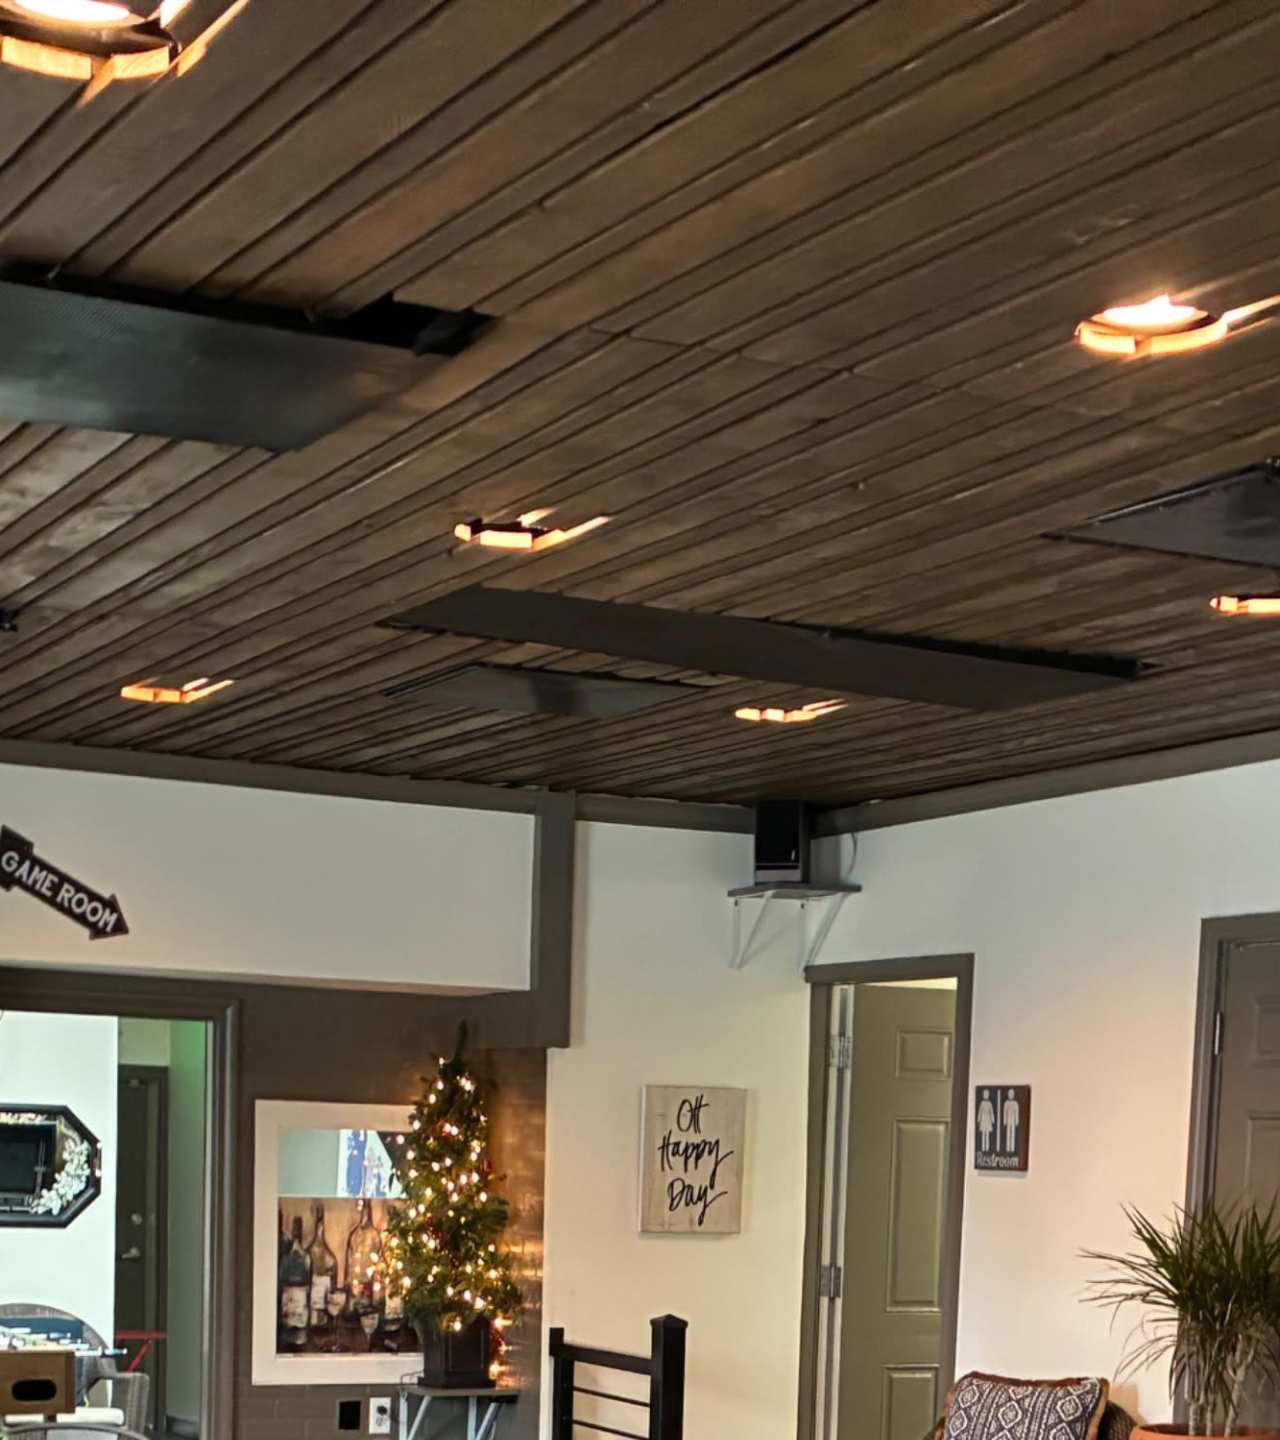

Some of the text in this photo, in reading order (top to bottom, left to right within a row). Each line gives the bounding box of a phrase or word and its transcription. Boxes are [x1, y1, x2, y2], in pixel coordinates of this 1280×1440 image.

[1, 851, 118, 932] GAME ROOM
[657, 1130, 734, 1190] Happy
[976, 1151, 1019, 1169] Restroom
[667, 1177, 728, 1227] Day
